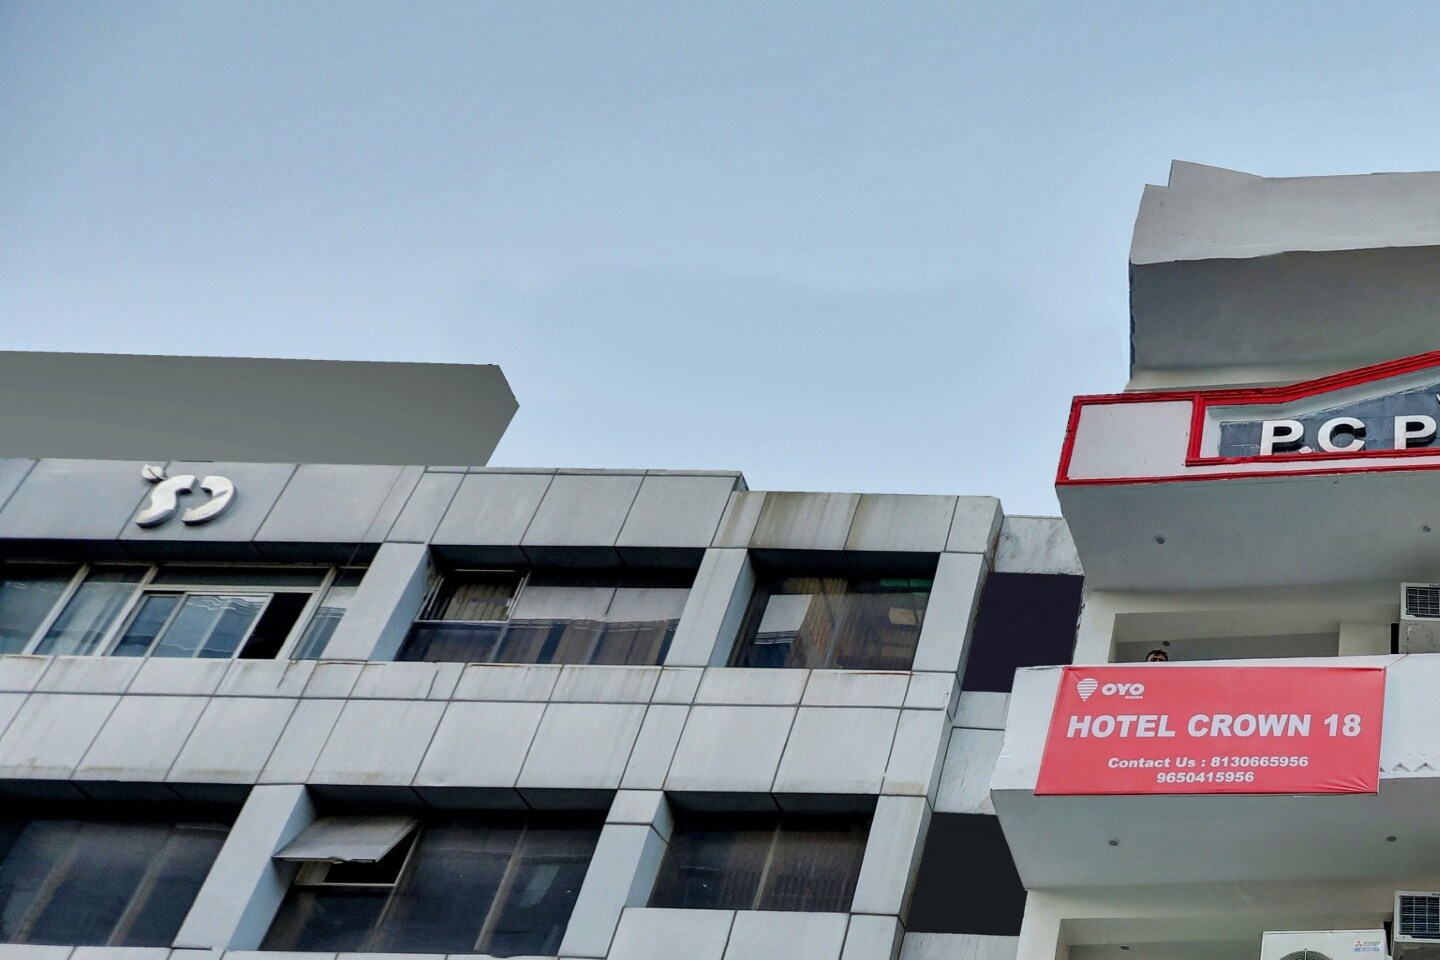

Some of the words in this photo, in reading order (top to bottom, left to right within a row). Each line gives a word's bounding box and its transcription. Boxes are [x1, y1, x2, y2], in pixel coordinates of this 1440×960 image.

[1101, 683, 1145, 696] OYO
[1066, 715, 1176, 738] HOTEL
[1187, 714, 1311, 738] CROWN
[1323, 713, 1362, 737] 18
[1107, 757, 1170, 768] Contact
[1176, 757, 1196, 768] Us
[1210, 756, 1309, 767] 8130665956
[1156, 772, 1255, 783] 9650415956
